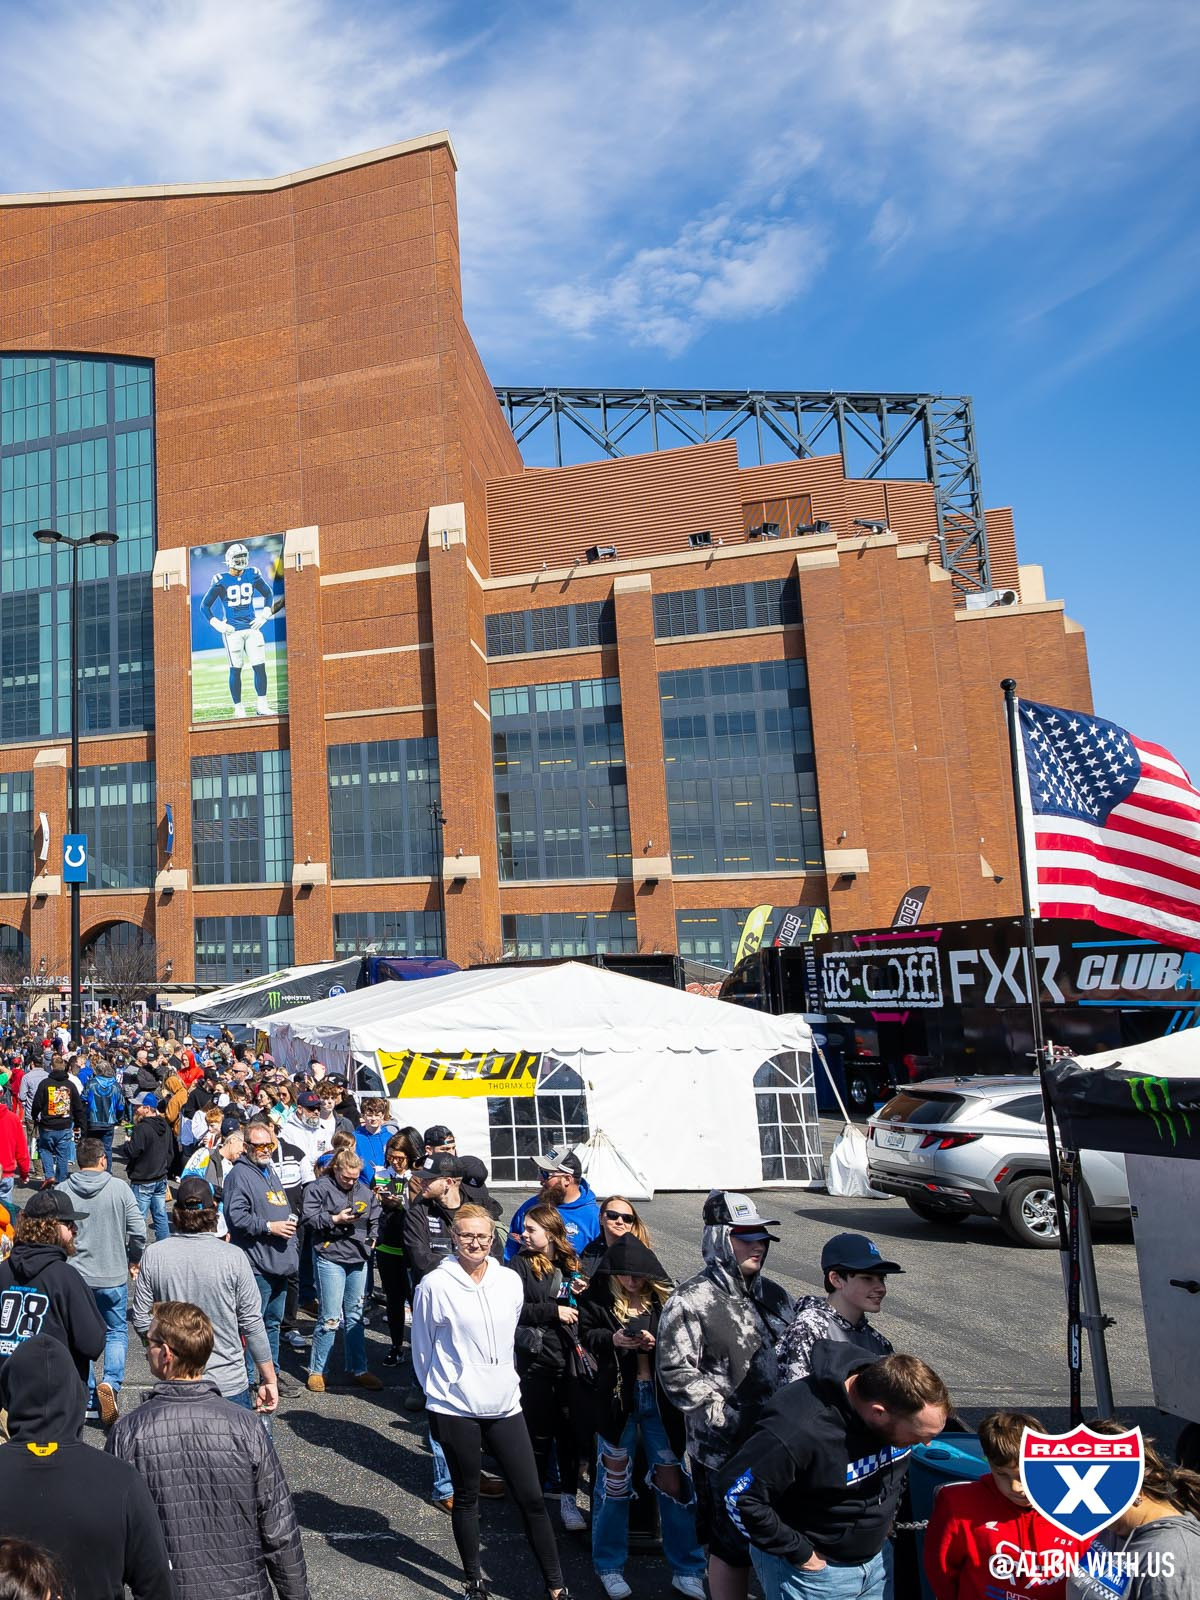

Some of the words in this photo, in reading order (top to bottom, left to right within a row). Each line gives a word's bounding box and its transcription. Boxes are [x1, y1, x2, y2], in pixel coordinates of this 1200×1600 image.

[226, 582, 254, 607] 99
[948, 945, 1066, 1004] FXR
[0, 1290, 50, 1338] 08
[1053, 1536, 1074, 1547] FOX
